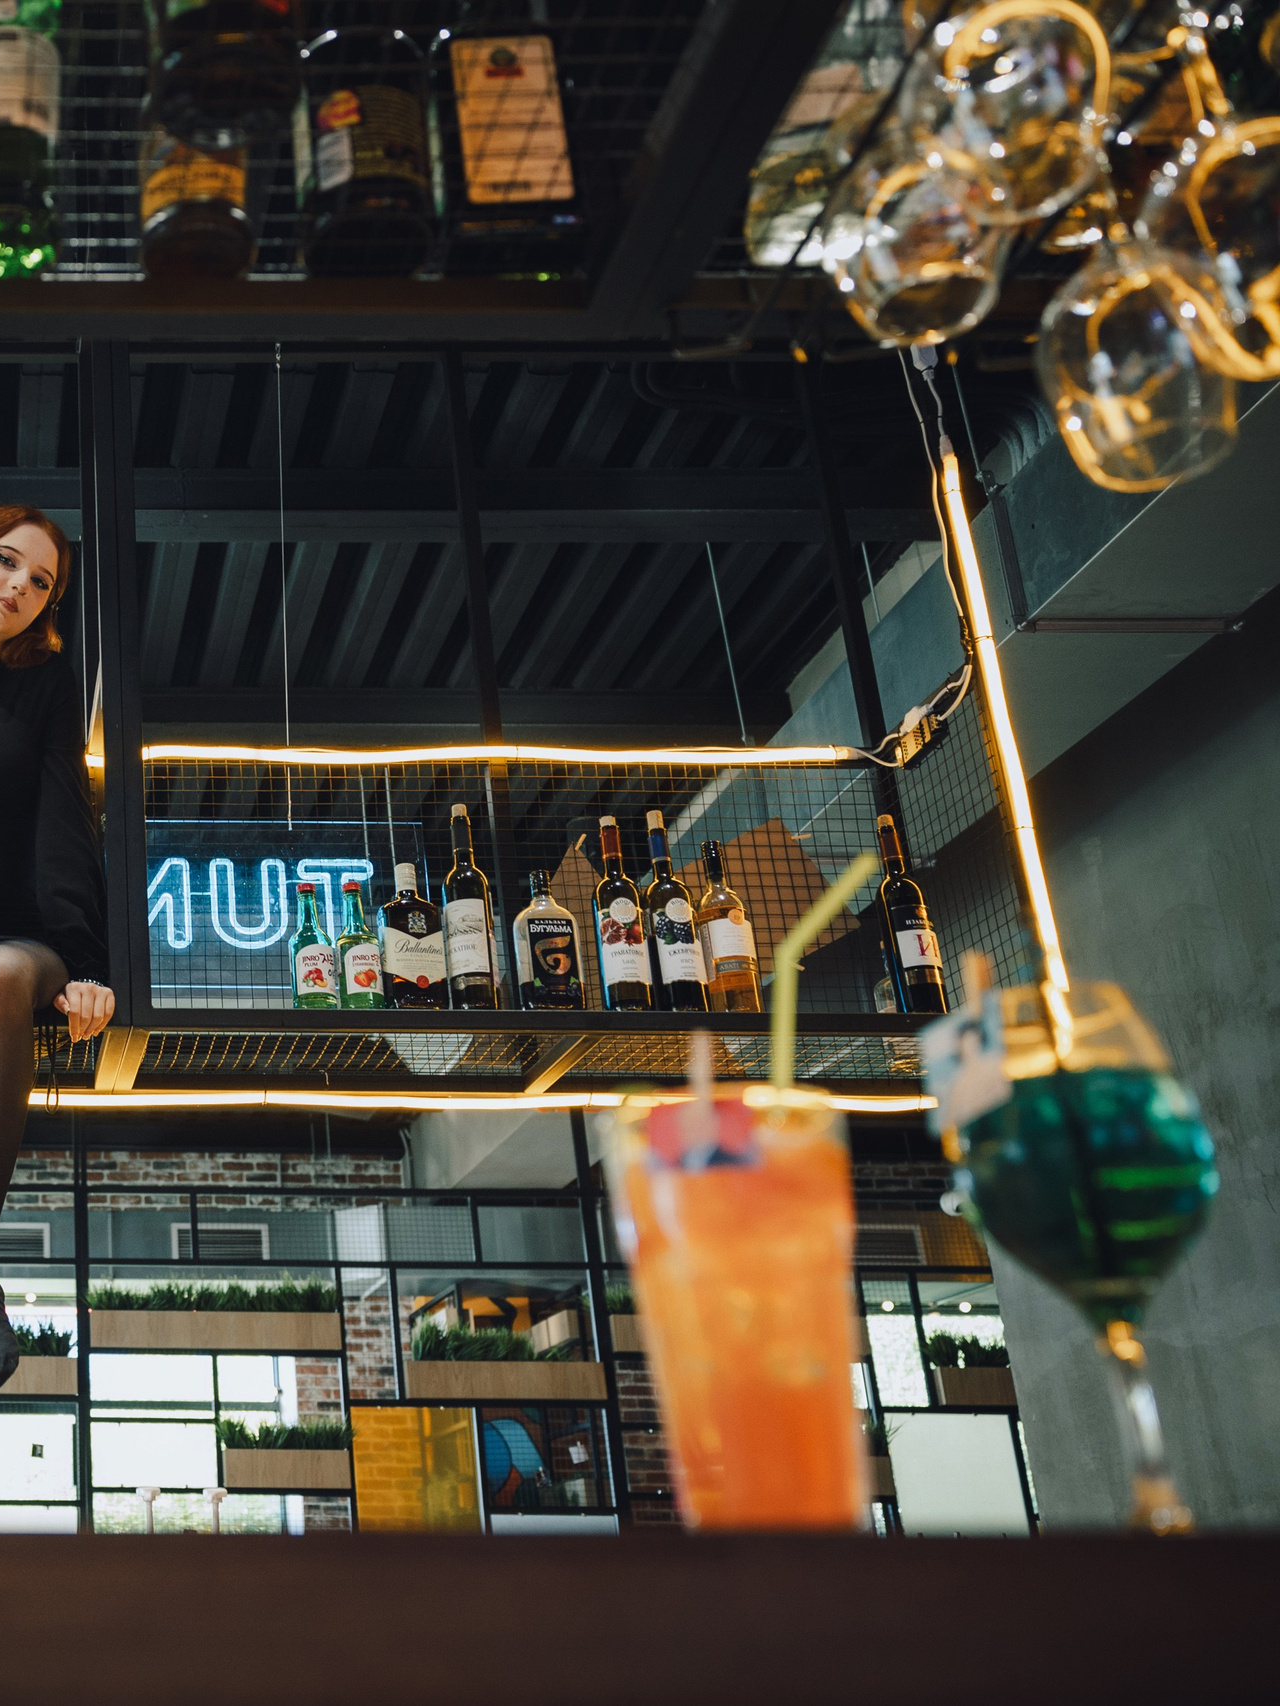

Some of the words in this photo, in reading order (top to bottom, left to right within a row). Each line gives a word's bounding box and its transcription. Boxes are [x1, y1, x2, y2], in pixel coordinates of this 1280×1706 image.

[529, 924, 573, 933] БУГУЛЬМА
[302, 954, 320, 963] JINRO
[352, 954, 370, 962] JINRO
